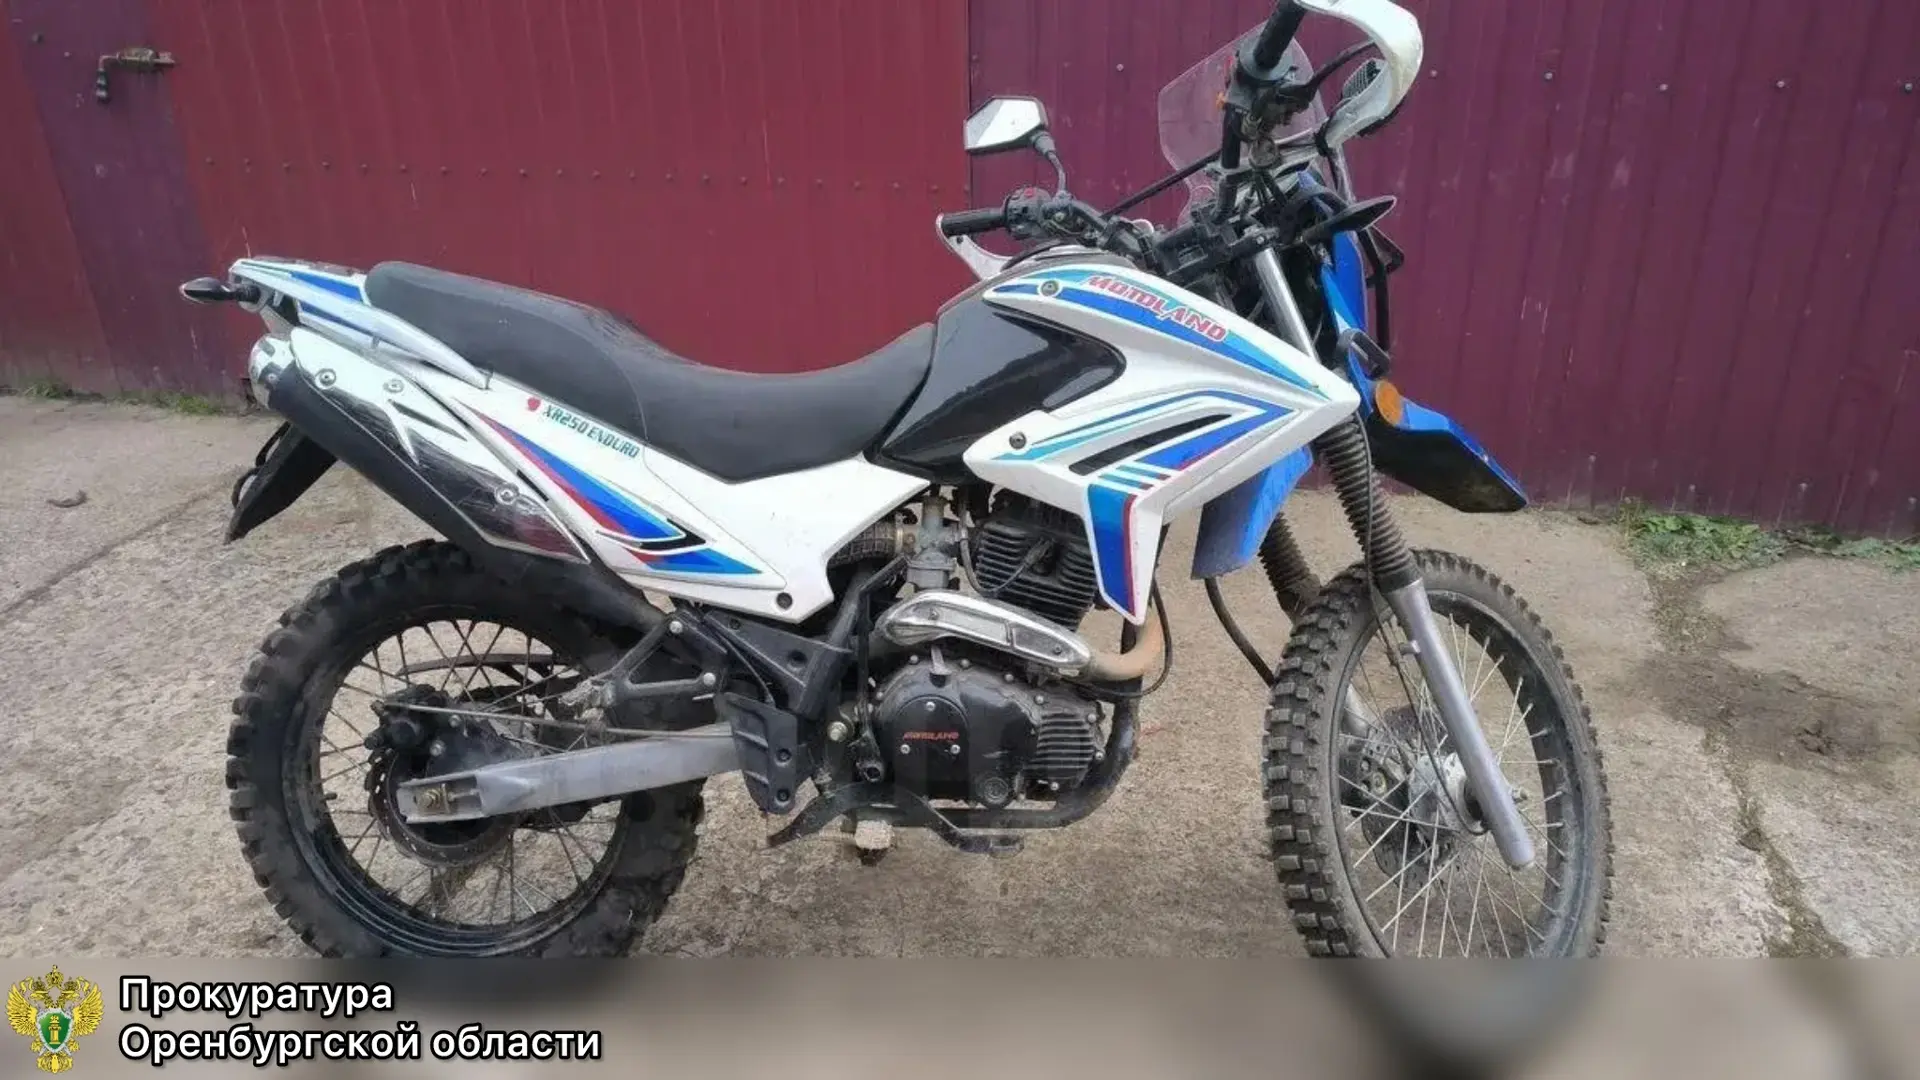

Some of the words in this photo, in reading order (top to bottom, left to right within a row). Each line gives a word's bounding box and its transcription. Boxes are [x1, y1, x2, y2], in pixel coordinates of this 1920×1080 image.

[1087, 276, 1228, 342] MOTOLAND
[543, 404, 588, 434] XR250
[588, 426, 640, 458] ENDURO
